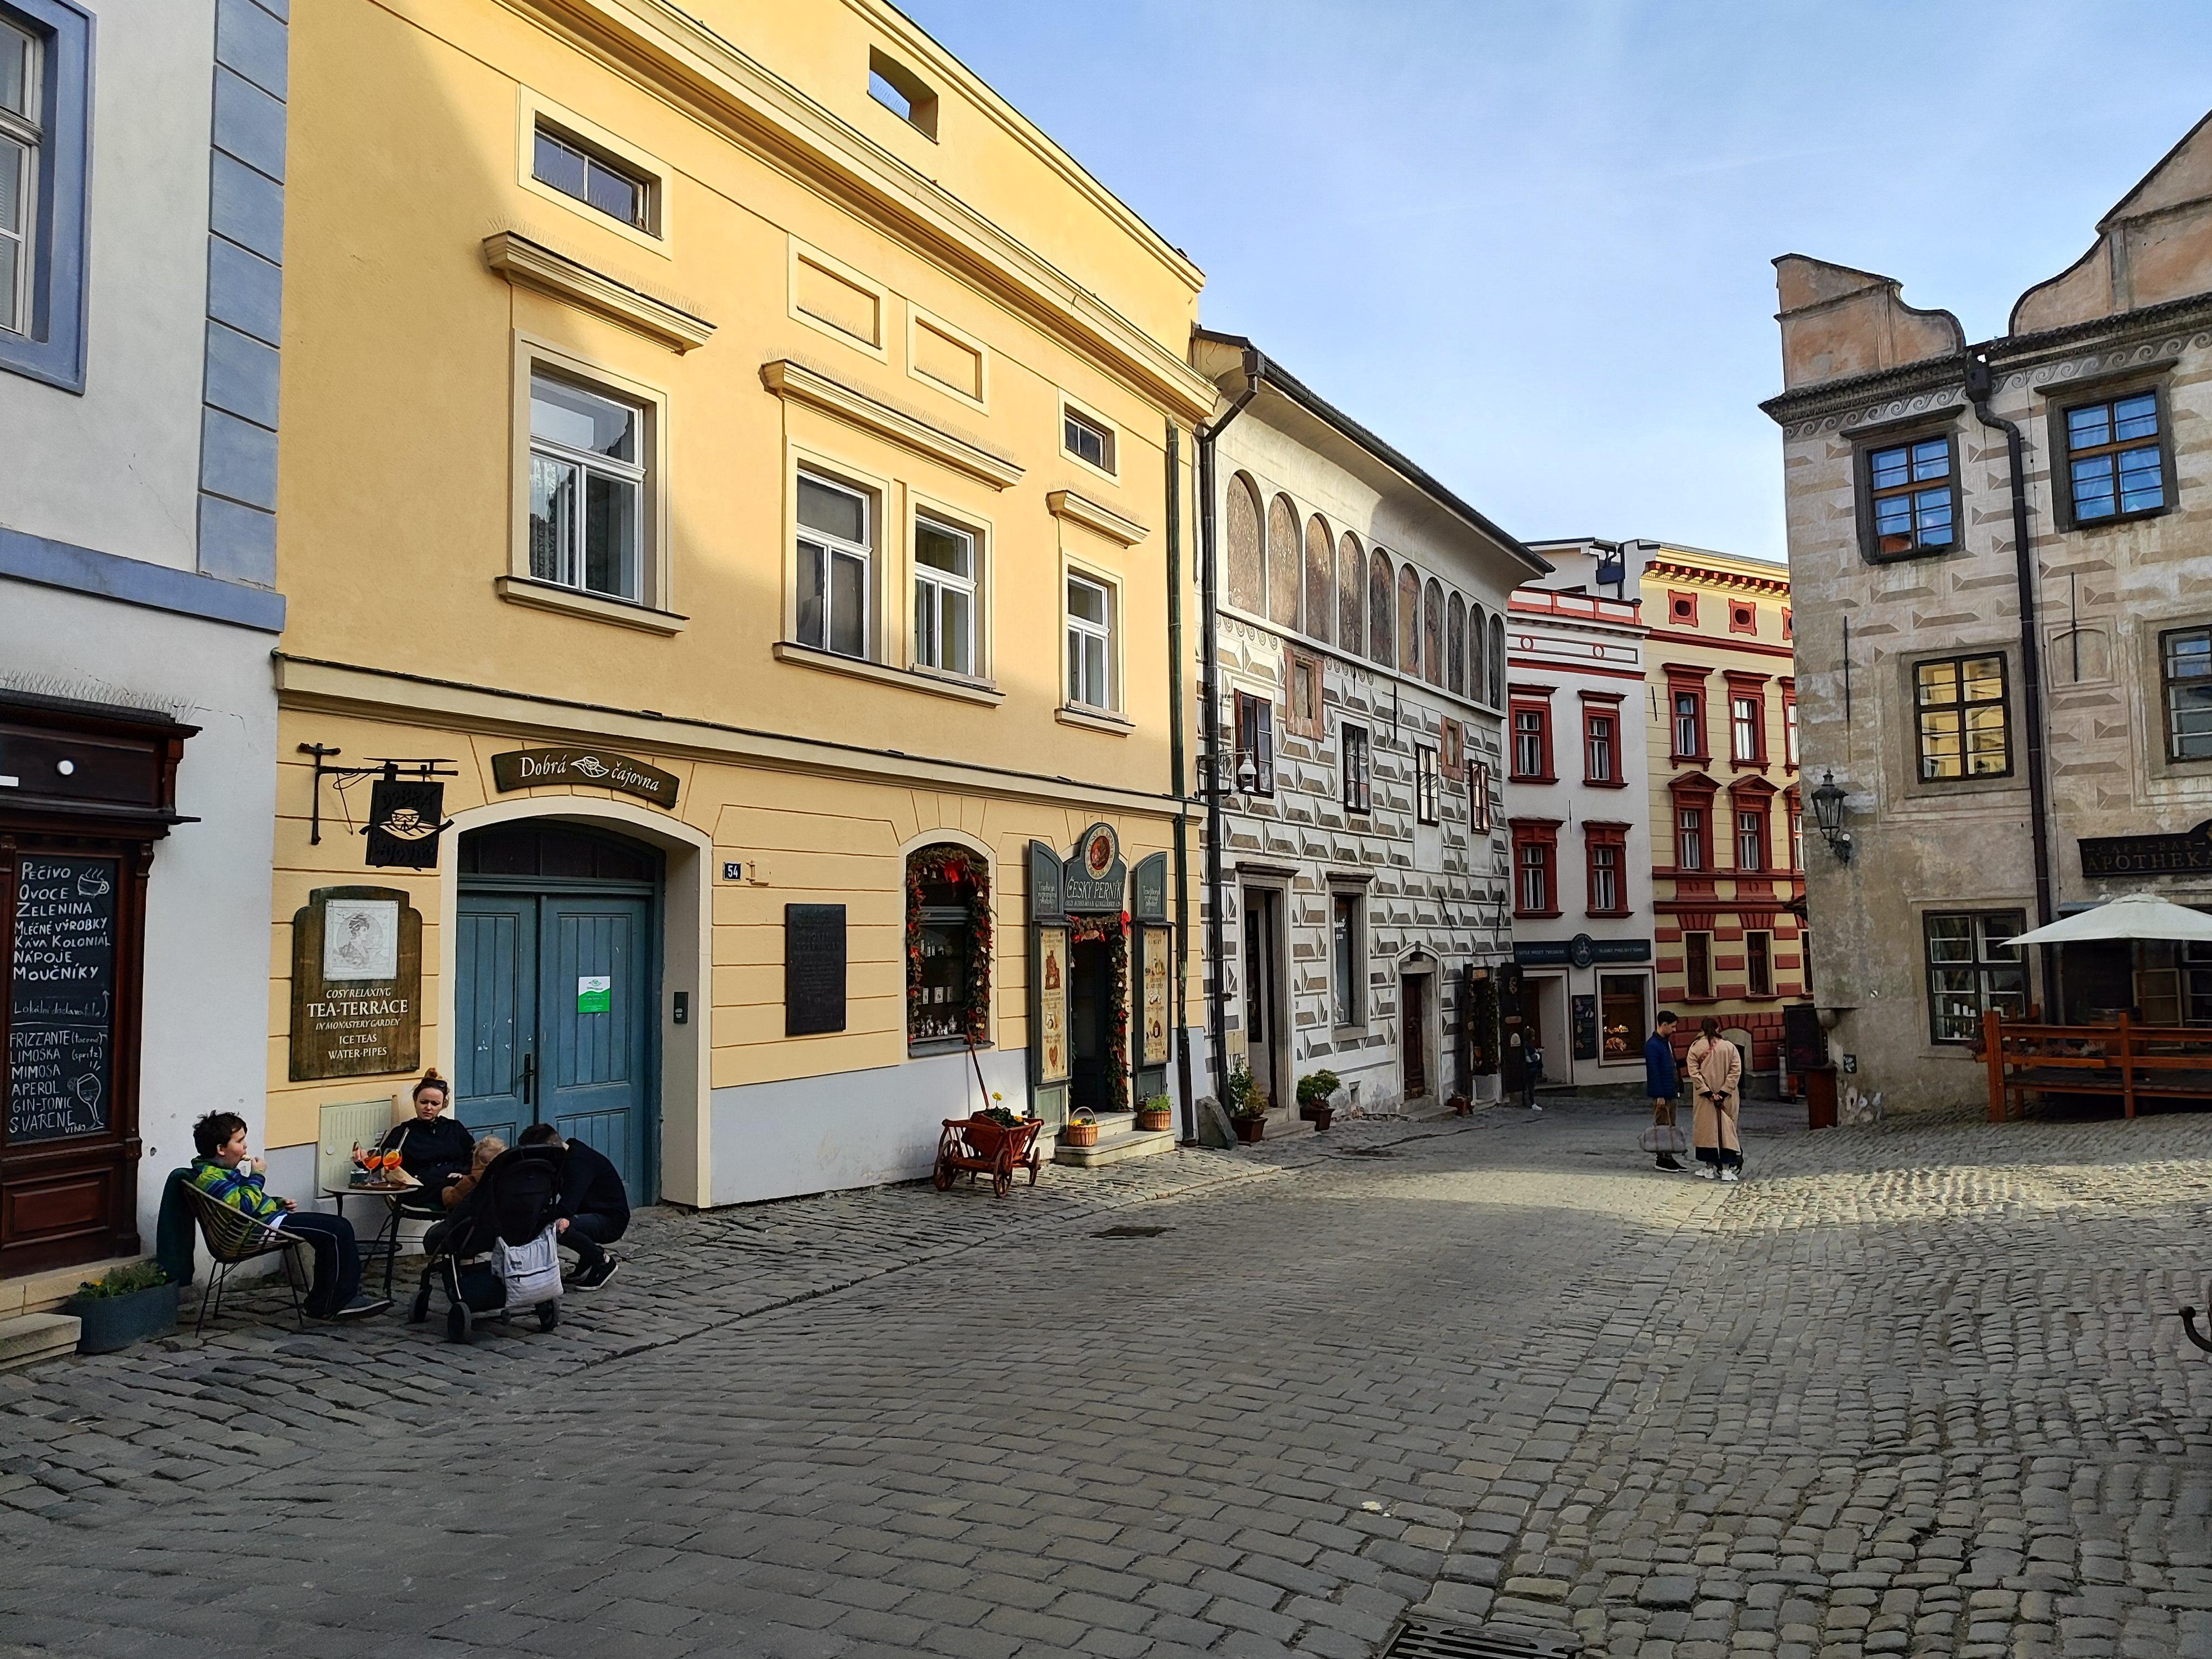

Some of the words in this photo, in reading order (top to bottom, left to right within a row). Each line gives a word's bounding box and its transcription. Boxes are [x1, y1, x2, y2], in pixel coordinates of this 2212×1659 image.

[518, 754, 567, 778] Dobrá
[611, 761, 660, 791] čajovna
[728, 865, 738, 878] 54
[19, 884, 70, 901] OVOCE
[1067, 876, 1094, 900] ČESKÝ
[1094, 879, 1122, 901] PERNÍK
[15, 901, 93, 917] ZELENINA
[14, 920, 52, 935] MLÉČNÉ
[55, 917, 108, 932] VÝROBKY
[14, 935, 48, 949] KÁVA
[52, 931, 111, 949] KOLONIÁL
[13, 948, 72, 964] NÁPOJE
[13, 962, 98, 981] MOUČNÍKY
[326, 989, 349, 999] COSY
[349, 987, 392, 998] RELAXING
[306, 999, 409, 1018] TEA-TERRACE
[315, 1022, 325, 1031] IN
[325, 1020, 371, 1030] MONASTERY
[371, 1018, 401, 1027] GARDEN
[9, 1030, 71, 1048] FRIZZANTE
[339, 1035, 354, 1045] ICE
[356, 1034, 378, 1044] TEAS
[71, 1046, 102, 1062] (spritz)
[328, 1046, 388, 1060] WATER-PIPES
[11, 1064, 61, 1080] MIMOSA
[11, 1079, 60, 1097] APEROL
[12, 1097, 72, 1113] GIN-TONIC
